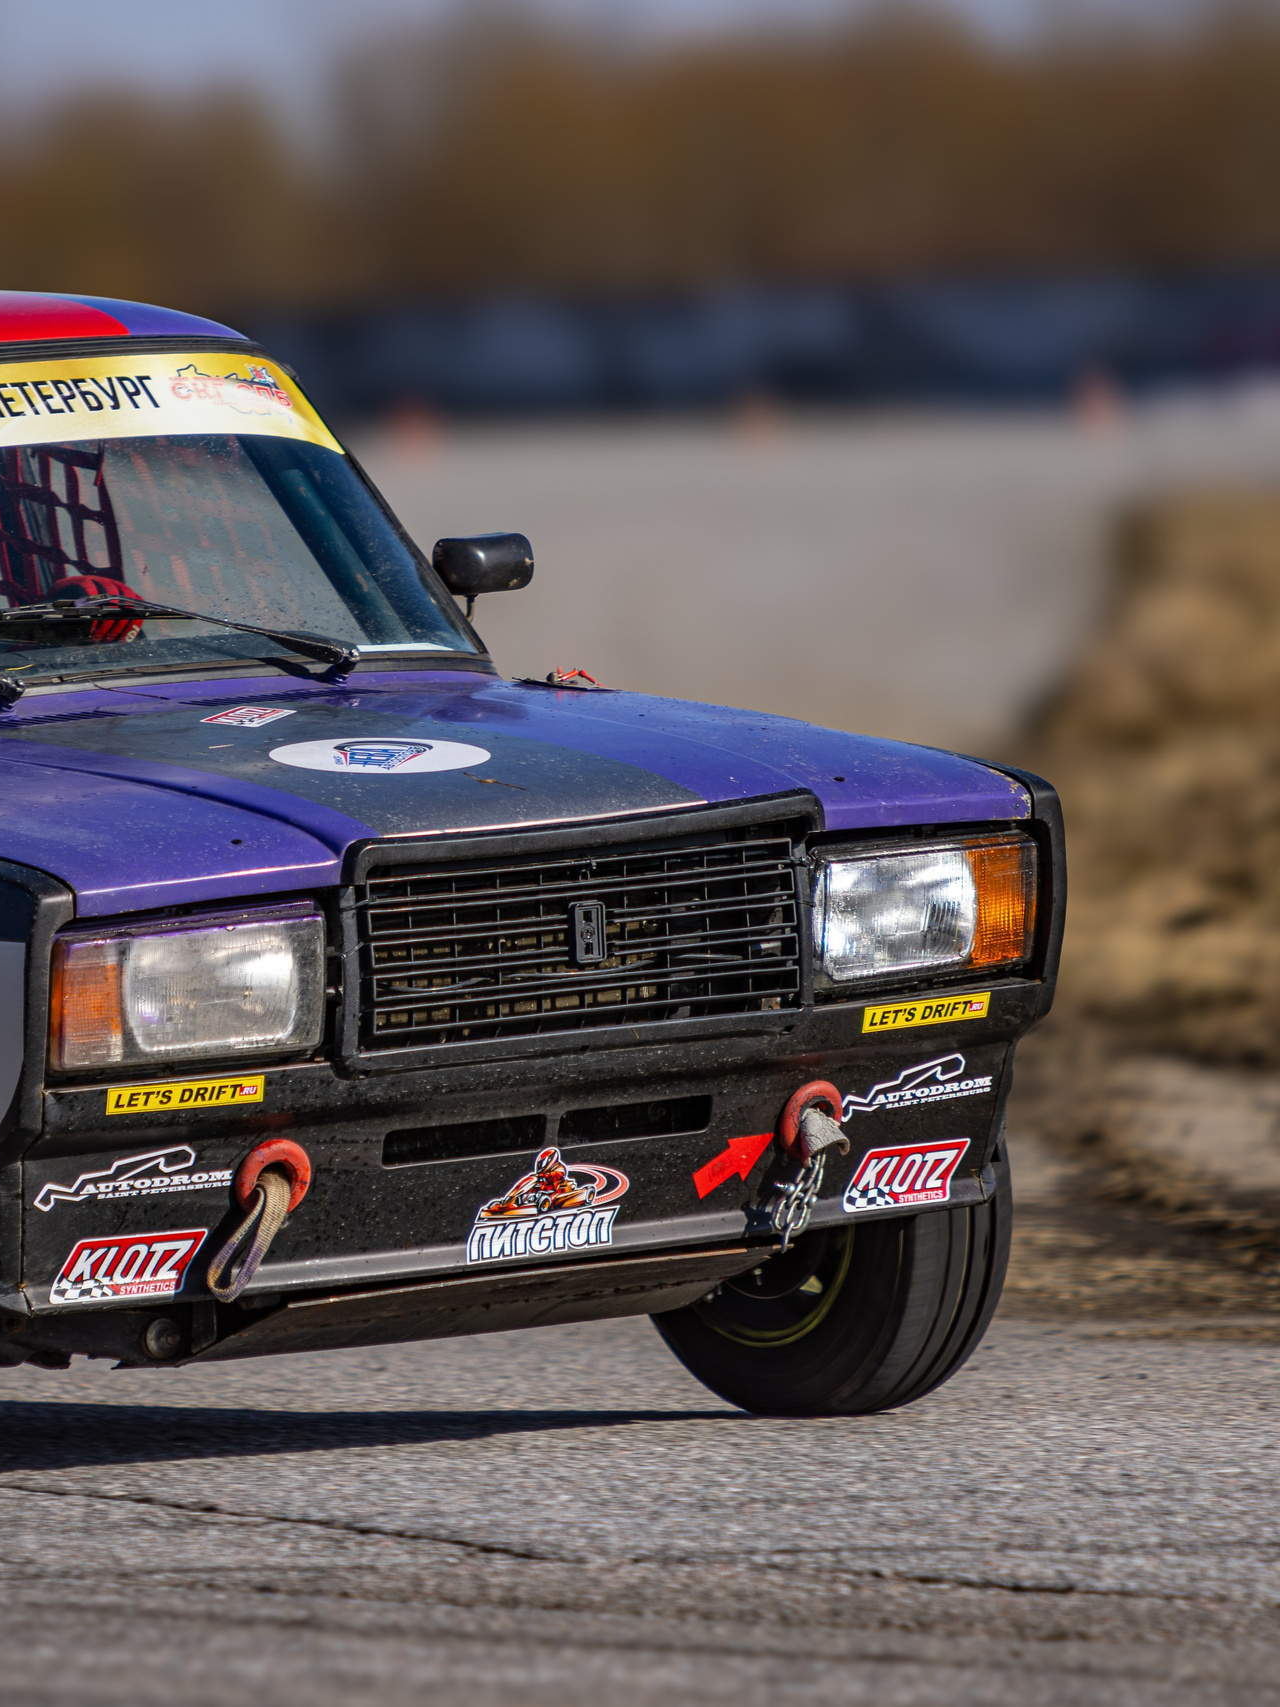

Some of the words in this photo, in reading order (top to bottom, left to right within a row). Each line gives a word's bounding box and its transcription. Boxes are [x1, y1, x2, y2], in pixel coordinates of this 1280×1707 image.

[869, 1008, 916, 1027] LET'S
[113, 1089, 173, 1110] LET'S
[872, 1076, 992, 1106] AUTODROM
[885, 1099, 918, 1109] SAINT
[855, 1148, 960, 1193] KLOTZ
[79, 1168, 233, 1196] AUTODROM
[97, 1189, 139, 1200] SAINT
[140, 1180, 232, 1196] PETERSBURG
[898, 1189, 944, 1203] SYNTHETICS
[468, 1206, 620, 1263] ПИТСТОП
[69, 1238, 197, 1285] KLOTZ
[119, 1280, 176, 1296] SYNTHETICS
